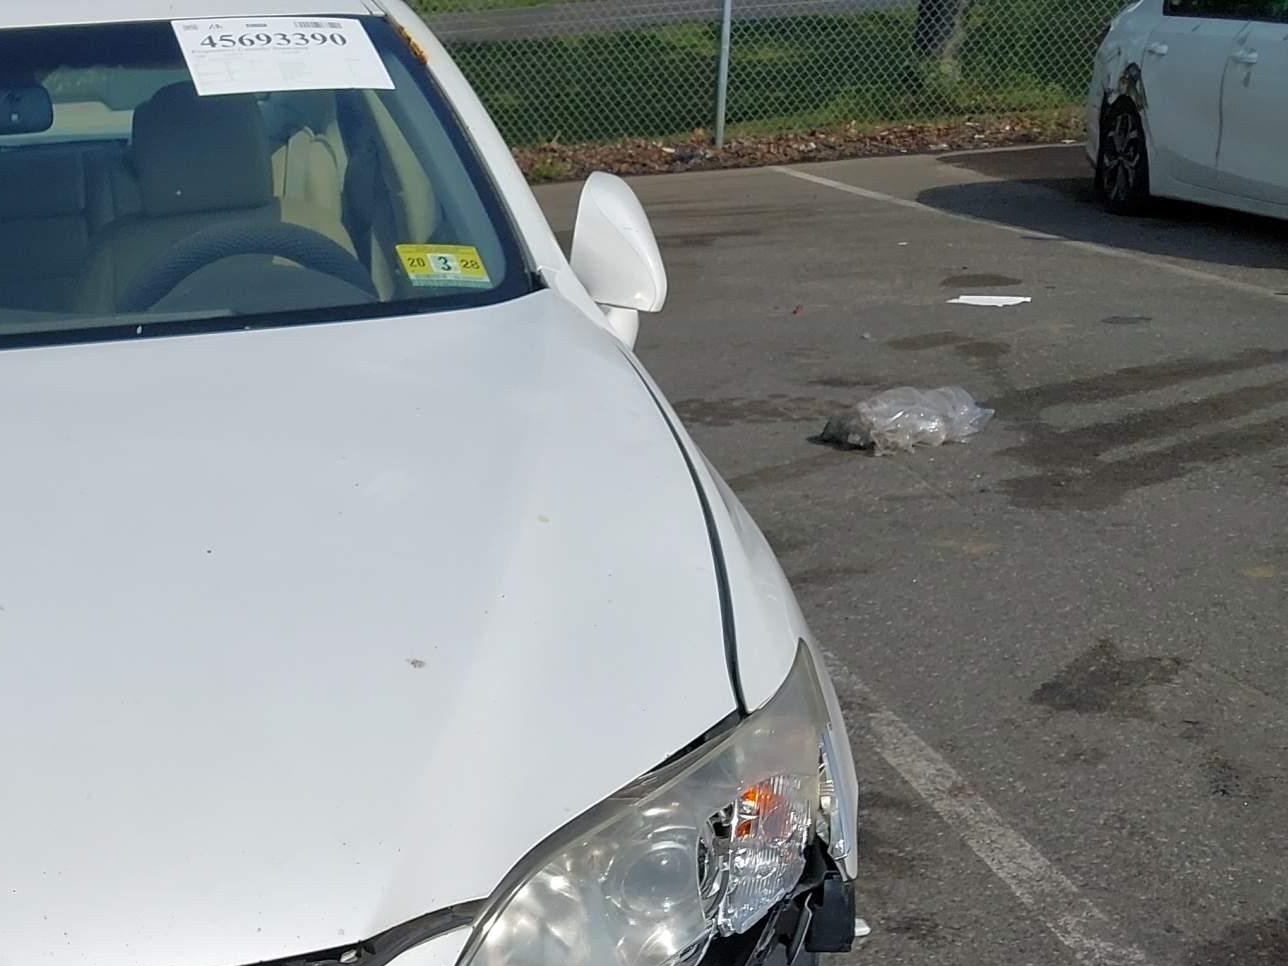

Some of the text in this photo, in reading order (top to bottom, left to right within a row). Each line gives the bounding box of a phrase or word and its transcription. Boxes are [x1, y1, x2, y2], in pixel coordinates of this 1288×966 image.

[200, 32, 347, 48] 45693390
[408, 257, 426, 268] 20
[438, 256, 452, 271] 3
